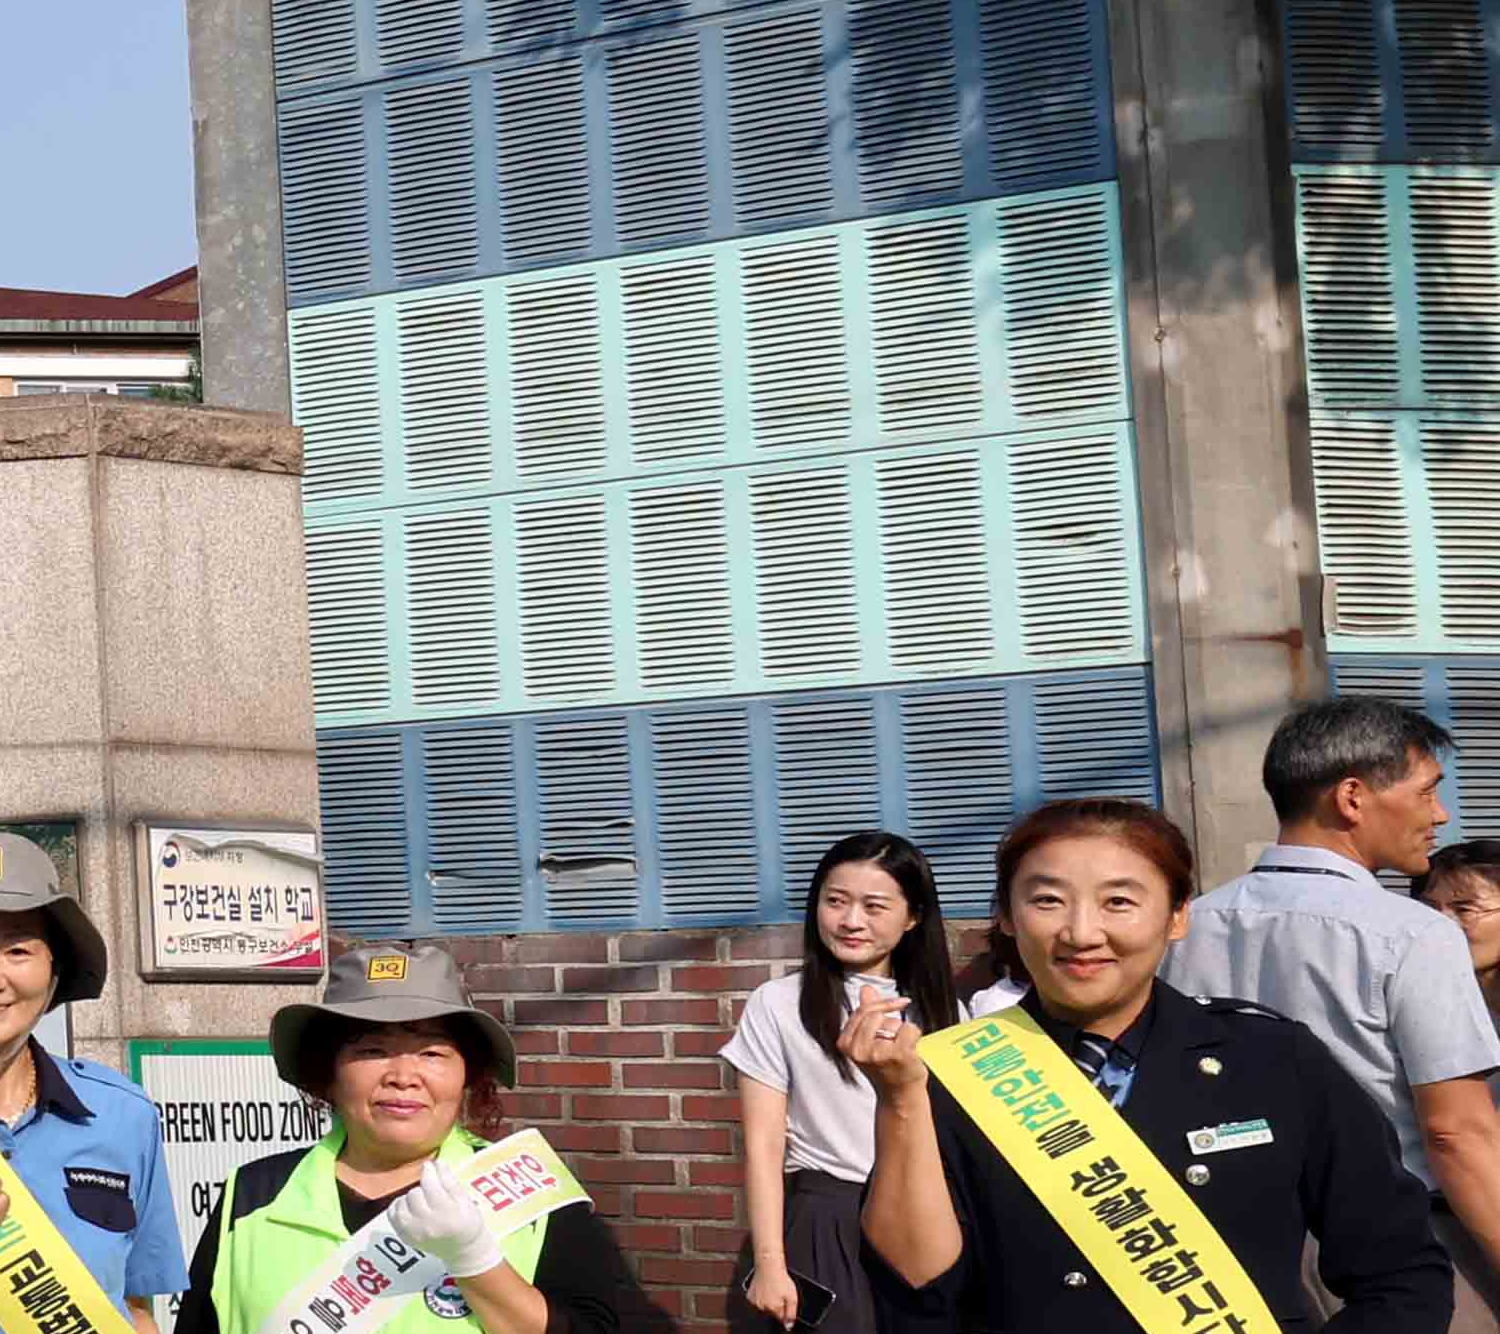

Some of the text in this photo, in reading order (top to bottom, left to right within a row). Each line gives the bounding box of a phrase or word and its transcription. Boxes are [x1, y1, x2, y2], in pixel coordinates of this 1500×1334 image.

[162, 883, 315, 924] 구강보건실 설치 학교
[220, 1100, 274, 1143] FOOD
[954, 1021, 1096, 1160] 교통안전을
[307, 1253, 391, 1334] 행복을
